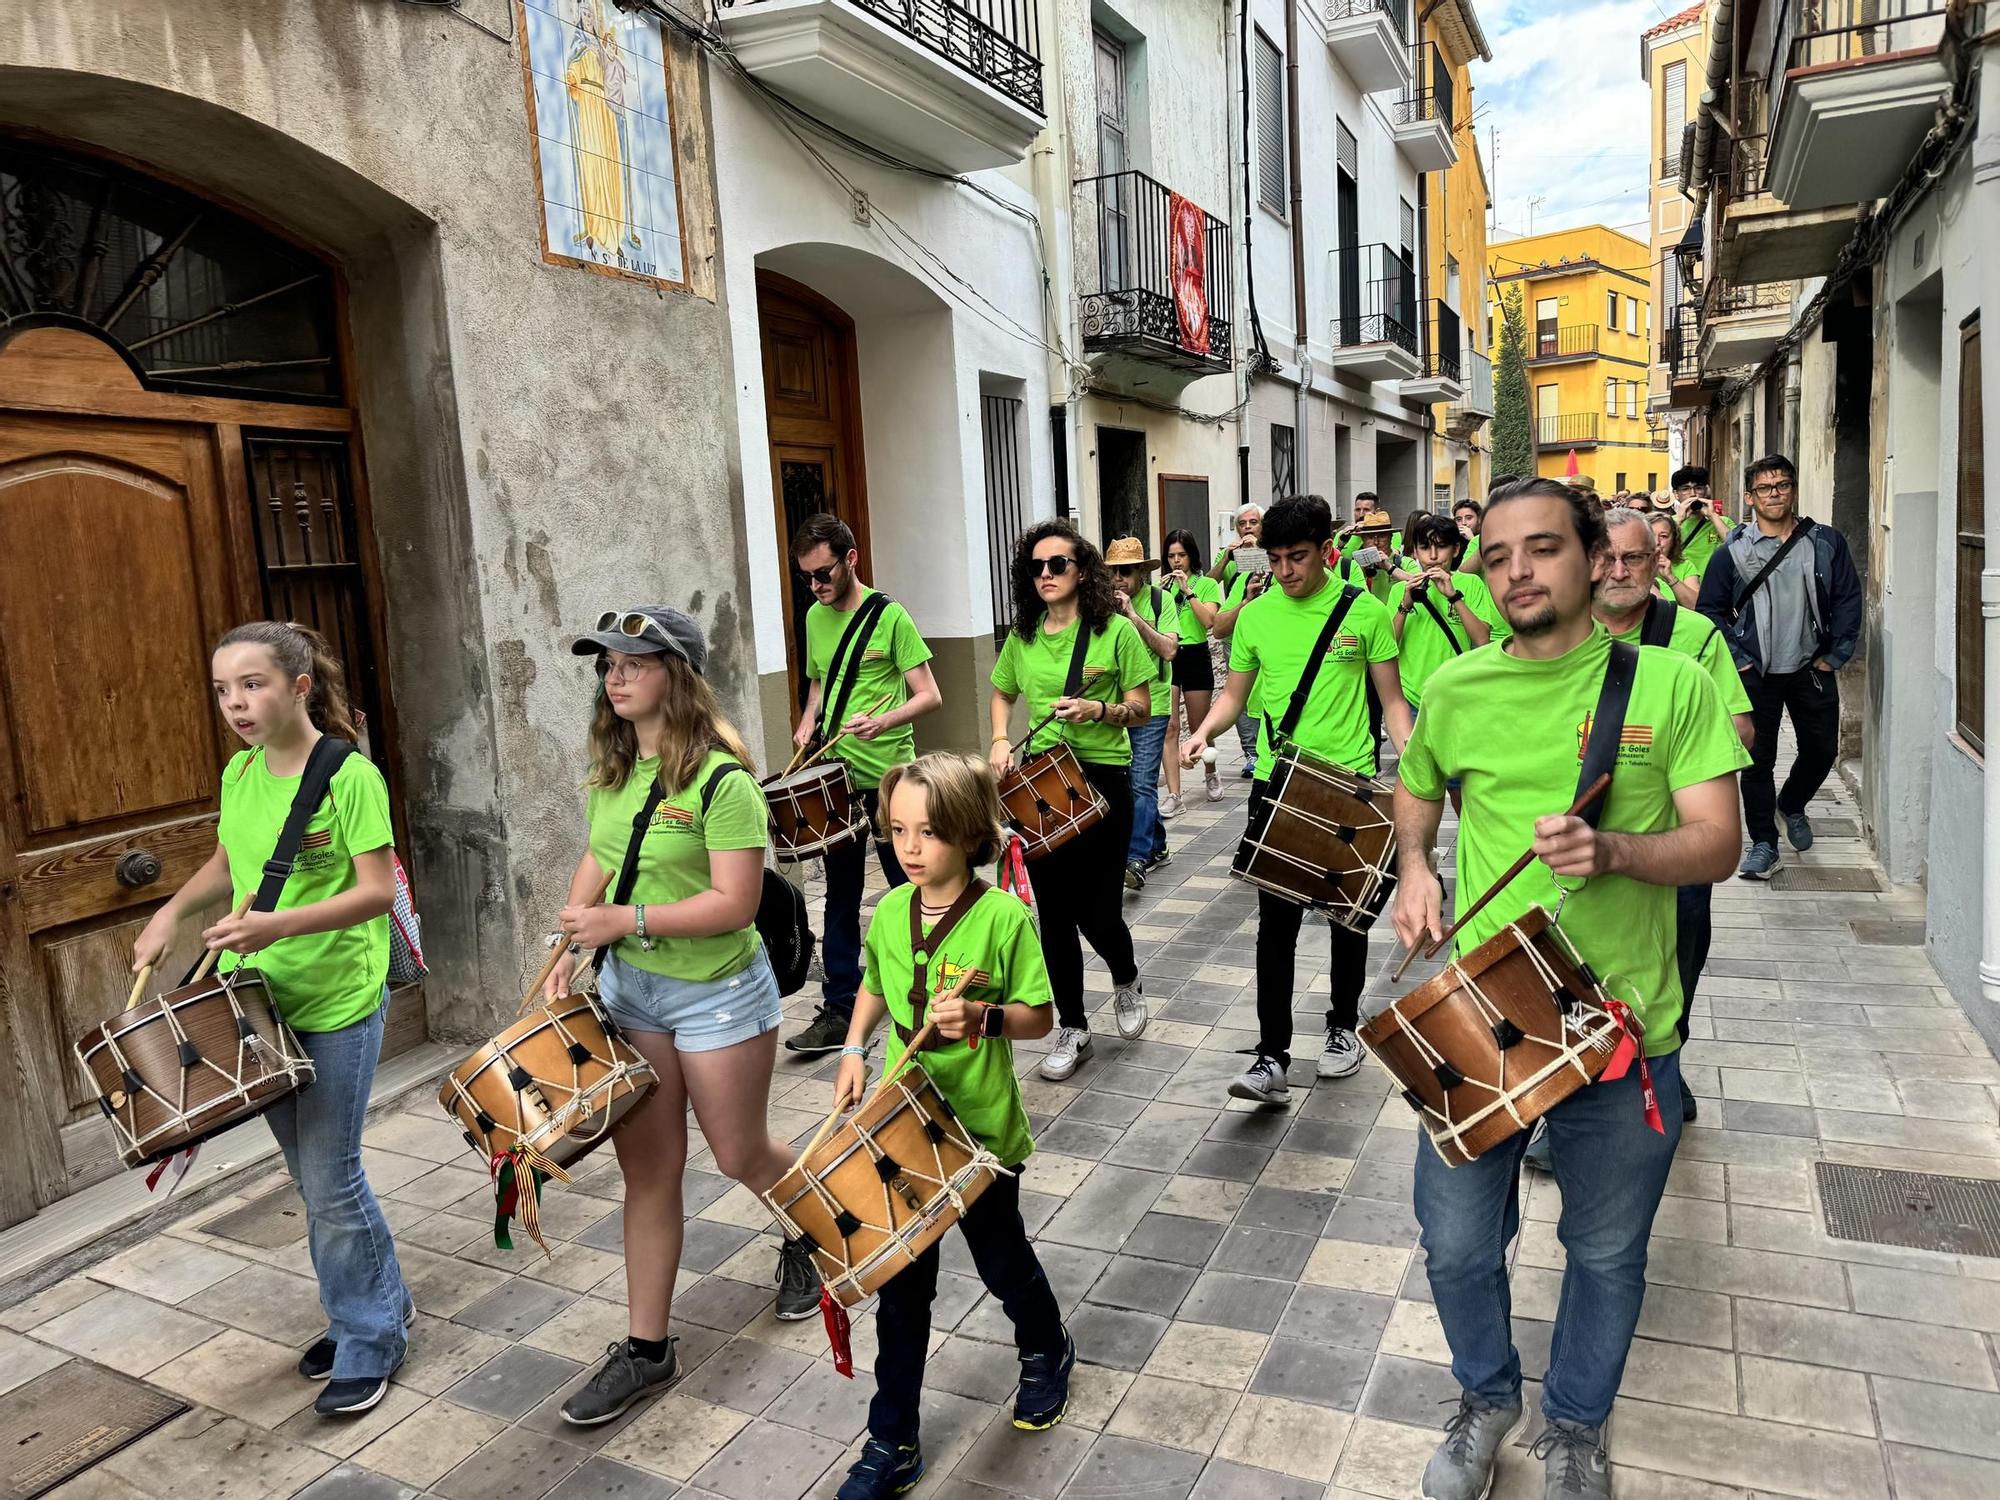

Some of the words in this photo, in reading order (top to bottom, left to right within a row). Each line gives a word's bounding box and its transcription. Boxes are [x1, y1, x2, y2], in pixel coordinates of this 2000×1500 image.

[617, 256, 629, 270] DE
[630, 259, 642, 273] LA
[643, 261, 657, 277] LUZ
[1628, 744, 1651, 753] Goles
[310, 850, 335, 861] Goles
